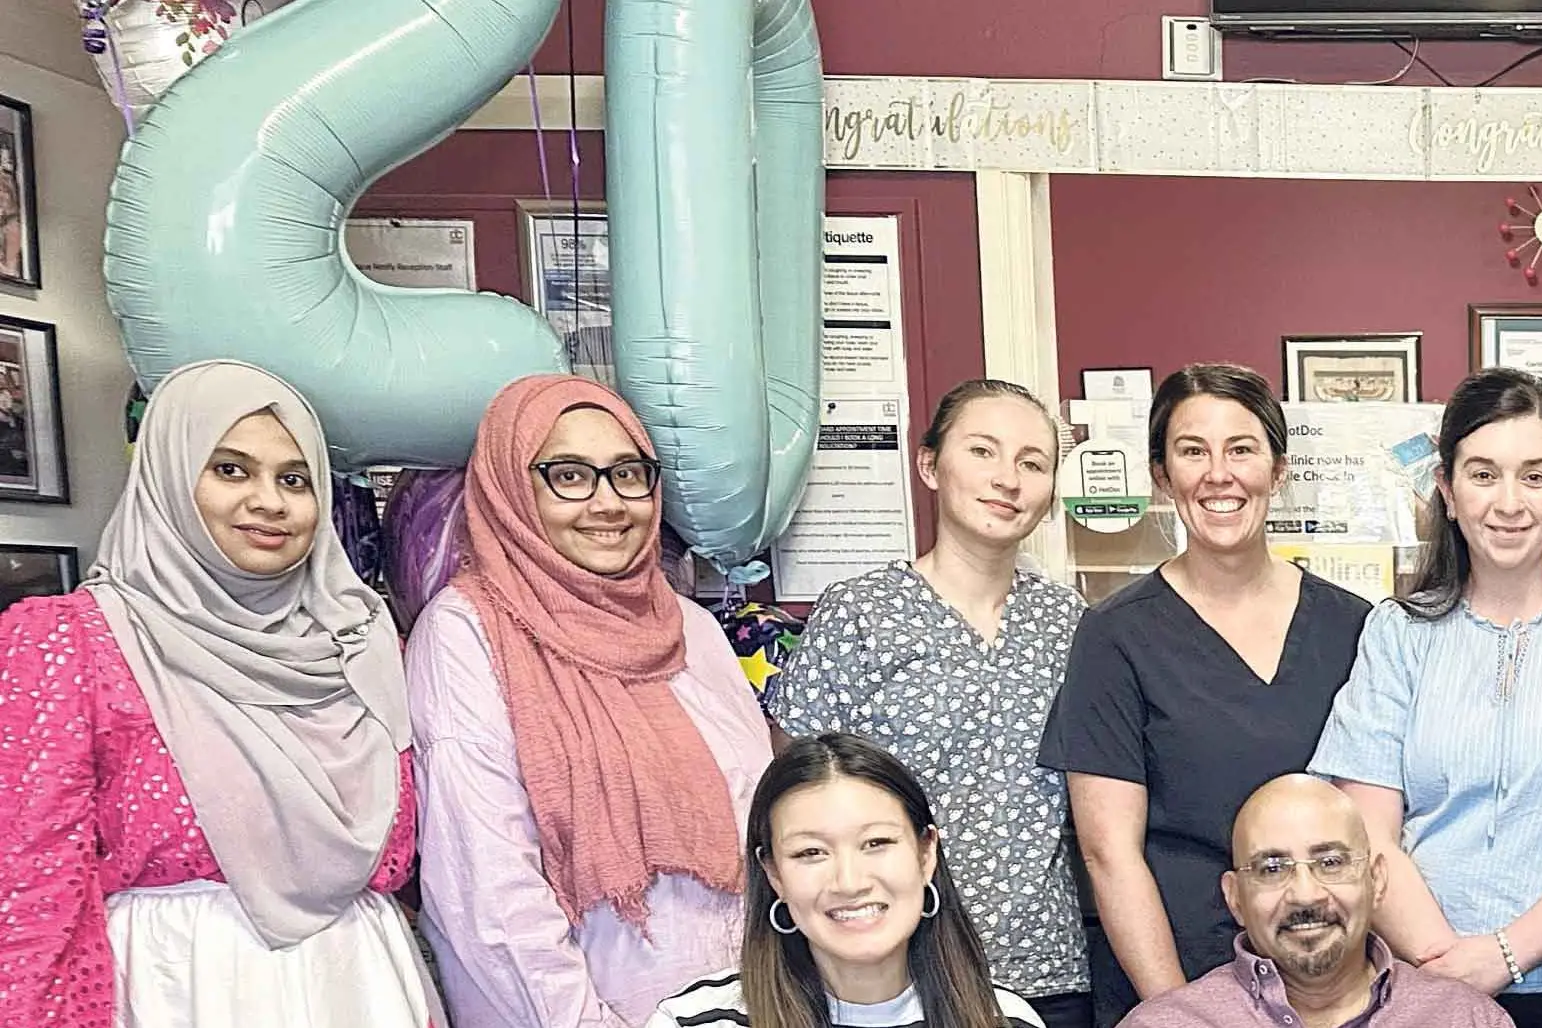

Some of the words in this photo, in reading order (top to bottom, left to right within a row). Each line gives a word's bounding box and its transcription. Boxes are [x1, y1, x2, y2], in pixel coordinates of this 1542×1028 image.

[824, 92, 1083, 160] ngratulations
[825, 231, 874, 246] tiquette
[1288, 424, 1324, 436] otDoc
